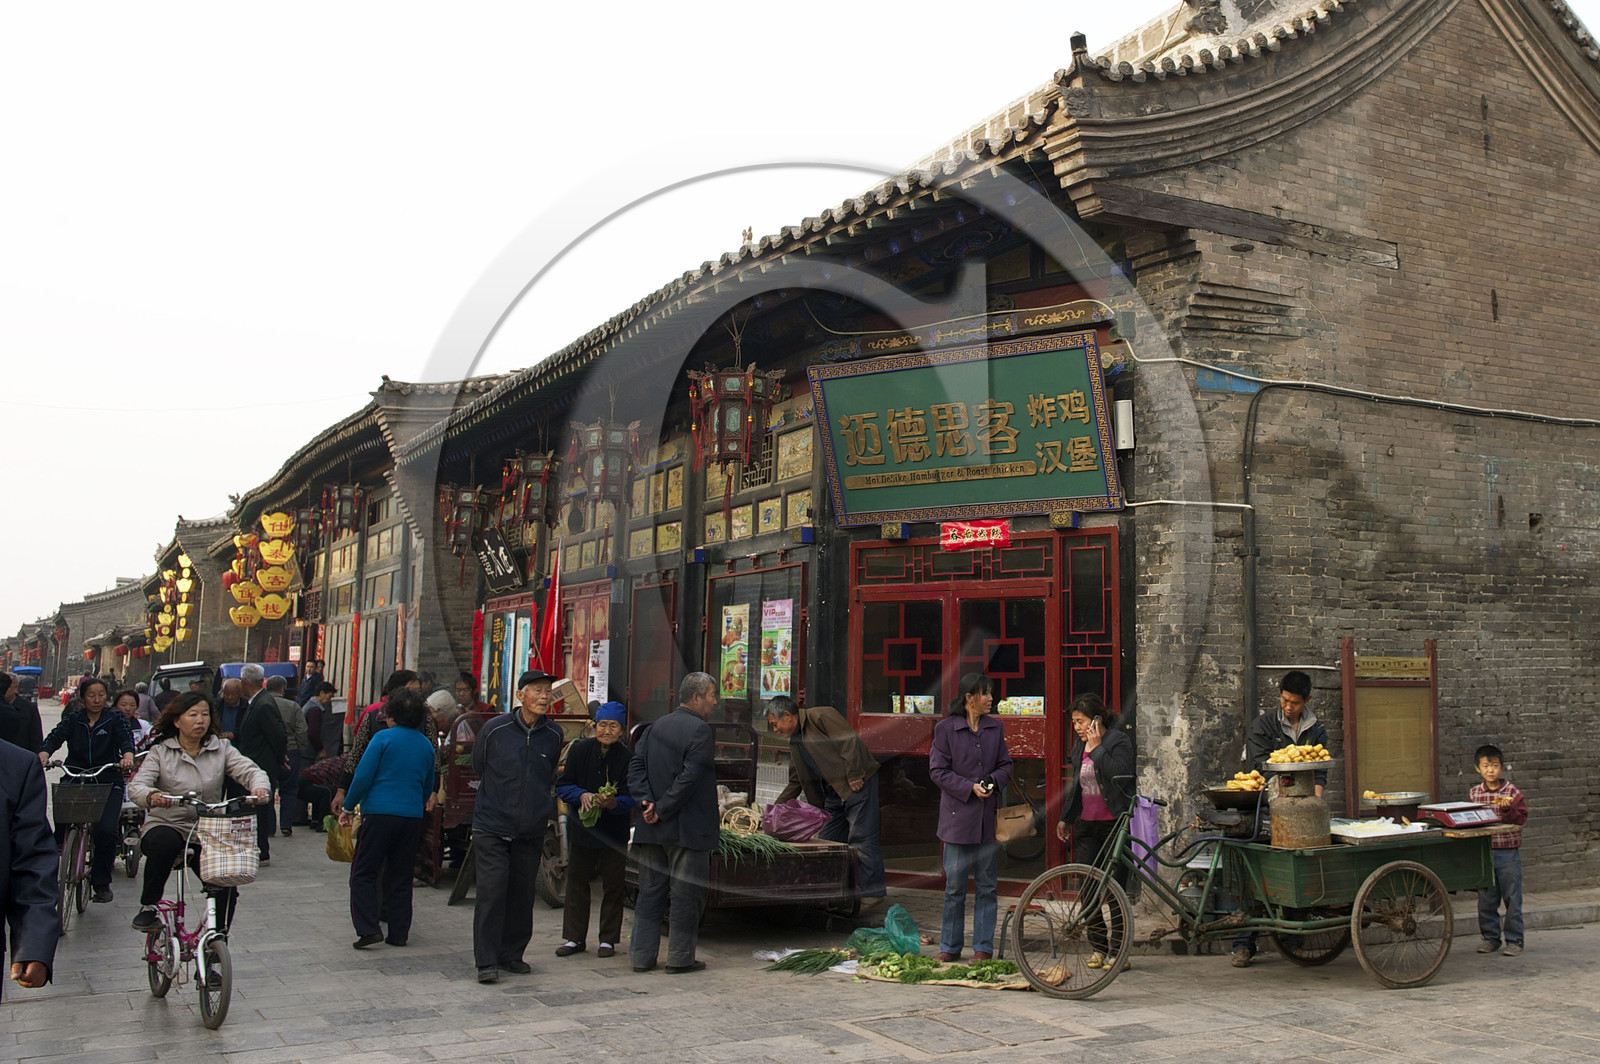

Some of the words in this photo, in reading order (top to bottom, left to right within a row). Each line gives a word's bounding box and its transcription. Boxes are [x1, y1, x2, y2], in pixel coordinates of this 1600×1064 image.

[1026, 390, 1090, 428] 炸鸡
[838, 398, 1020, 467] 迈德思客
[966, 467, 989, 477] Roast
[992, 464, 1025, 475] chicken
[1035, 436, 1098, 474] 汉堡
